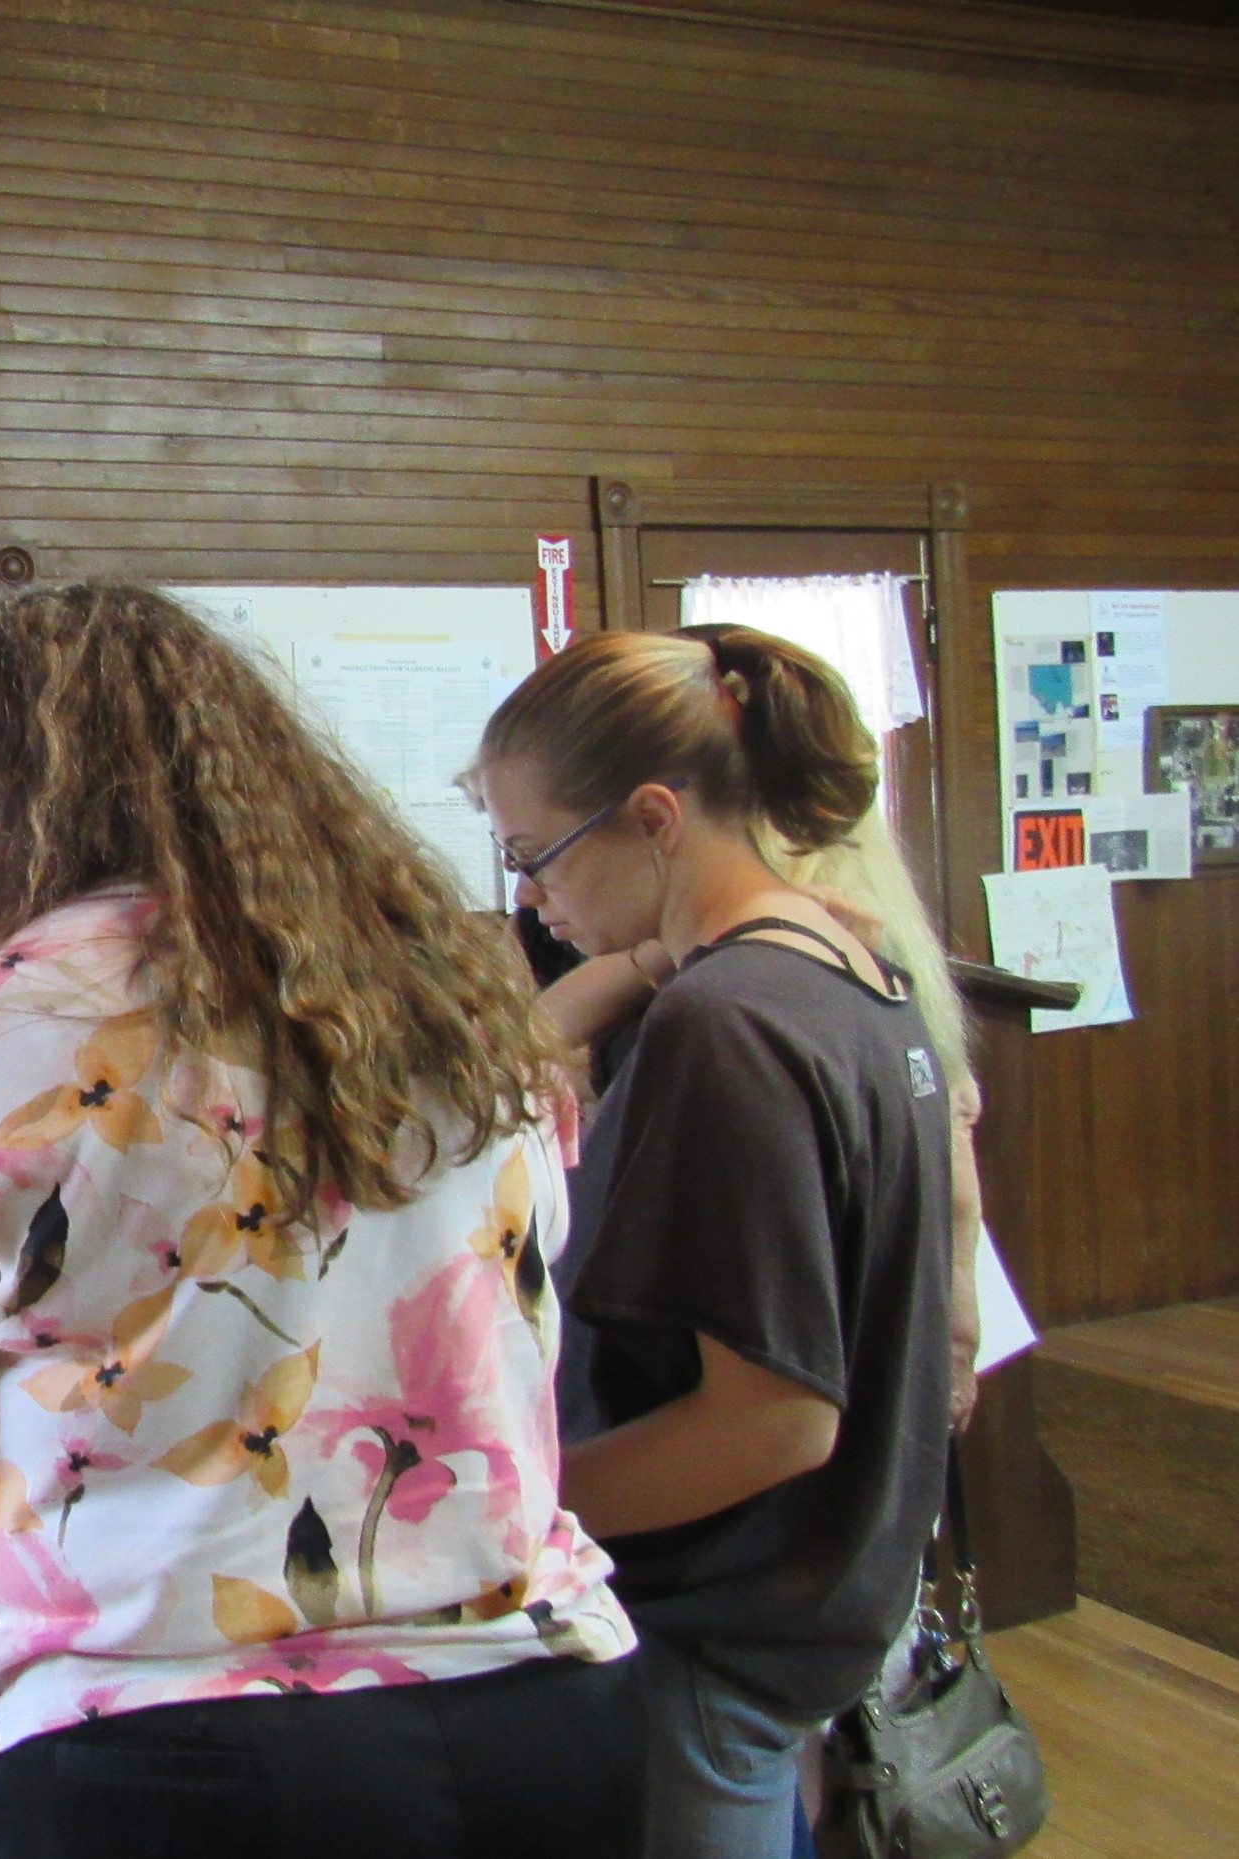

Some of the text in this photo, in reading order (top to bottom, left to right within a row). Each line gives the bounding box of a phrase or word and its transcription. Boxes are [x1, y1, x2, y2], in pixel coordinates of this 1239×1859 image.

[542, 548, 565, 564] FIRE
[552, 568, 560, 650] EXTINGUISHER
[1019, 816, 1083, 870] EXIT
